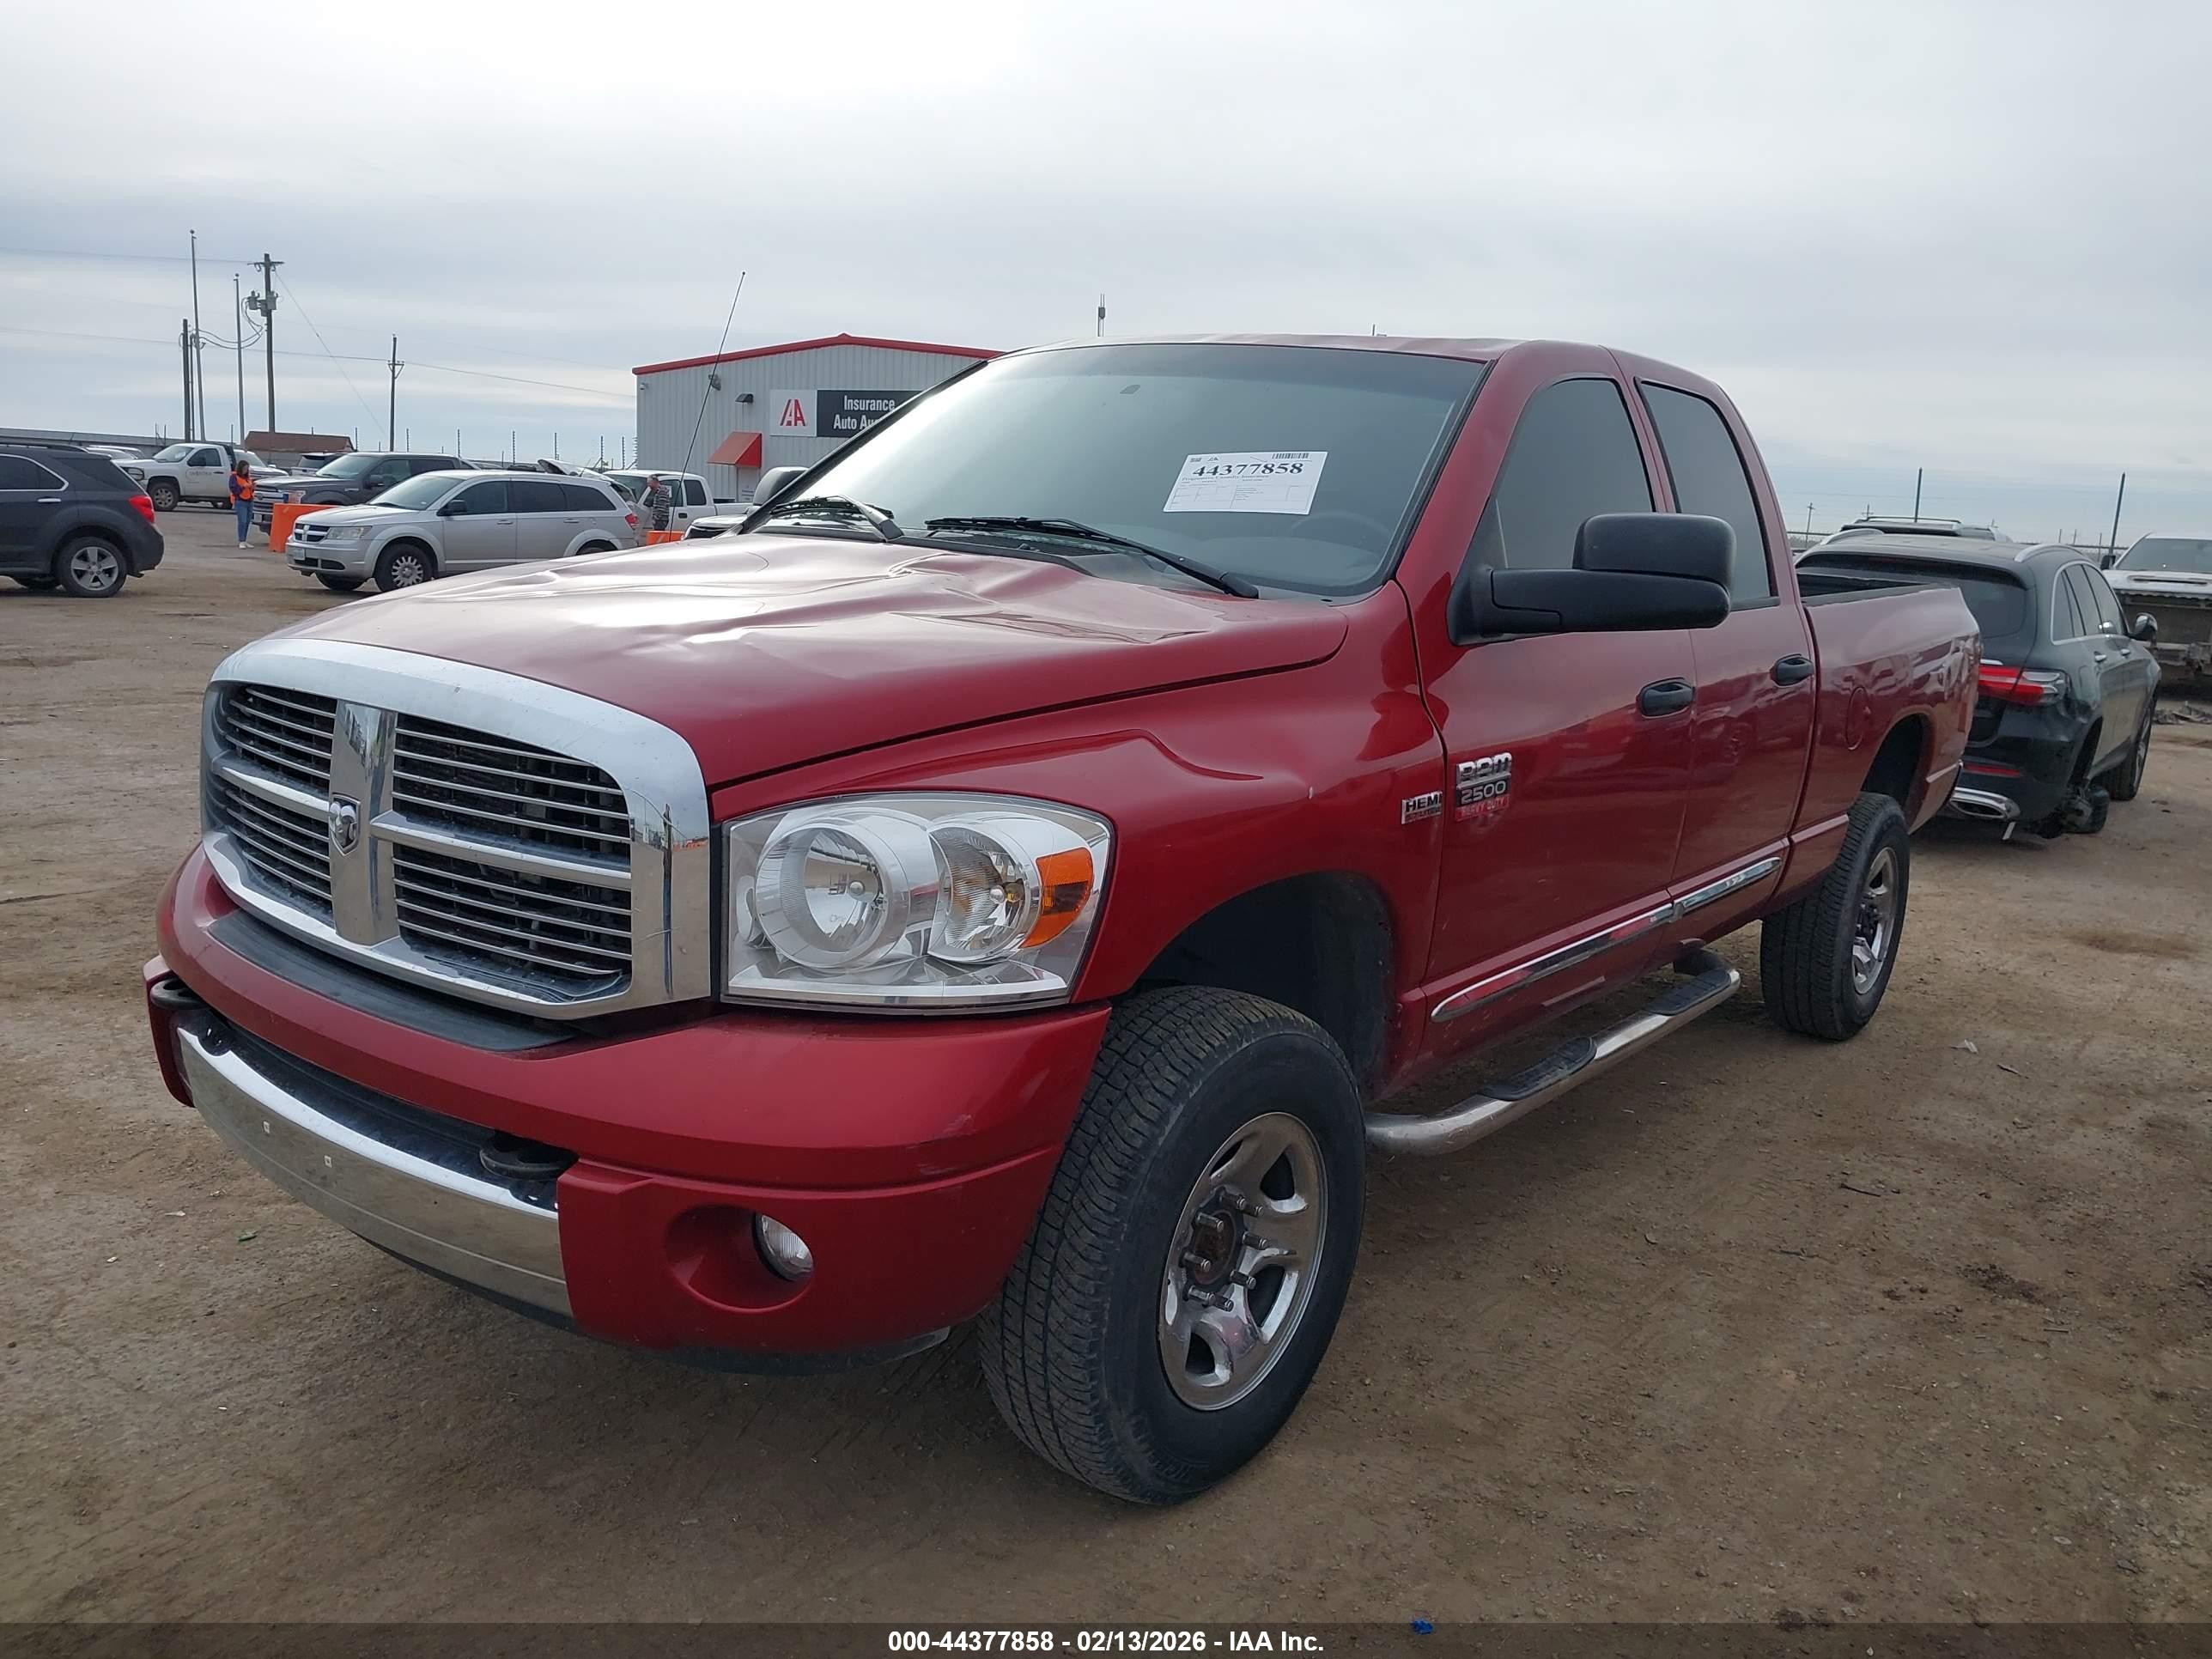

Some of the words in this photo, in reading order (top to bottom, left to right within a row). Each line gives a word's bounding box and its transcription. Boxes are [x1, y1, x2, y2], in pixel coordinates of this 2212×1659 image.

[843, 395, 896, 411] Insurance
[833, 414, 857, 430] Auto
[1192, 462, 1304, 477] 44377858
[1461, 780, 1506, 805] 2500
[1405, 790, 1443, 813] HEMI
